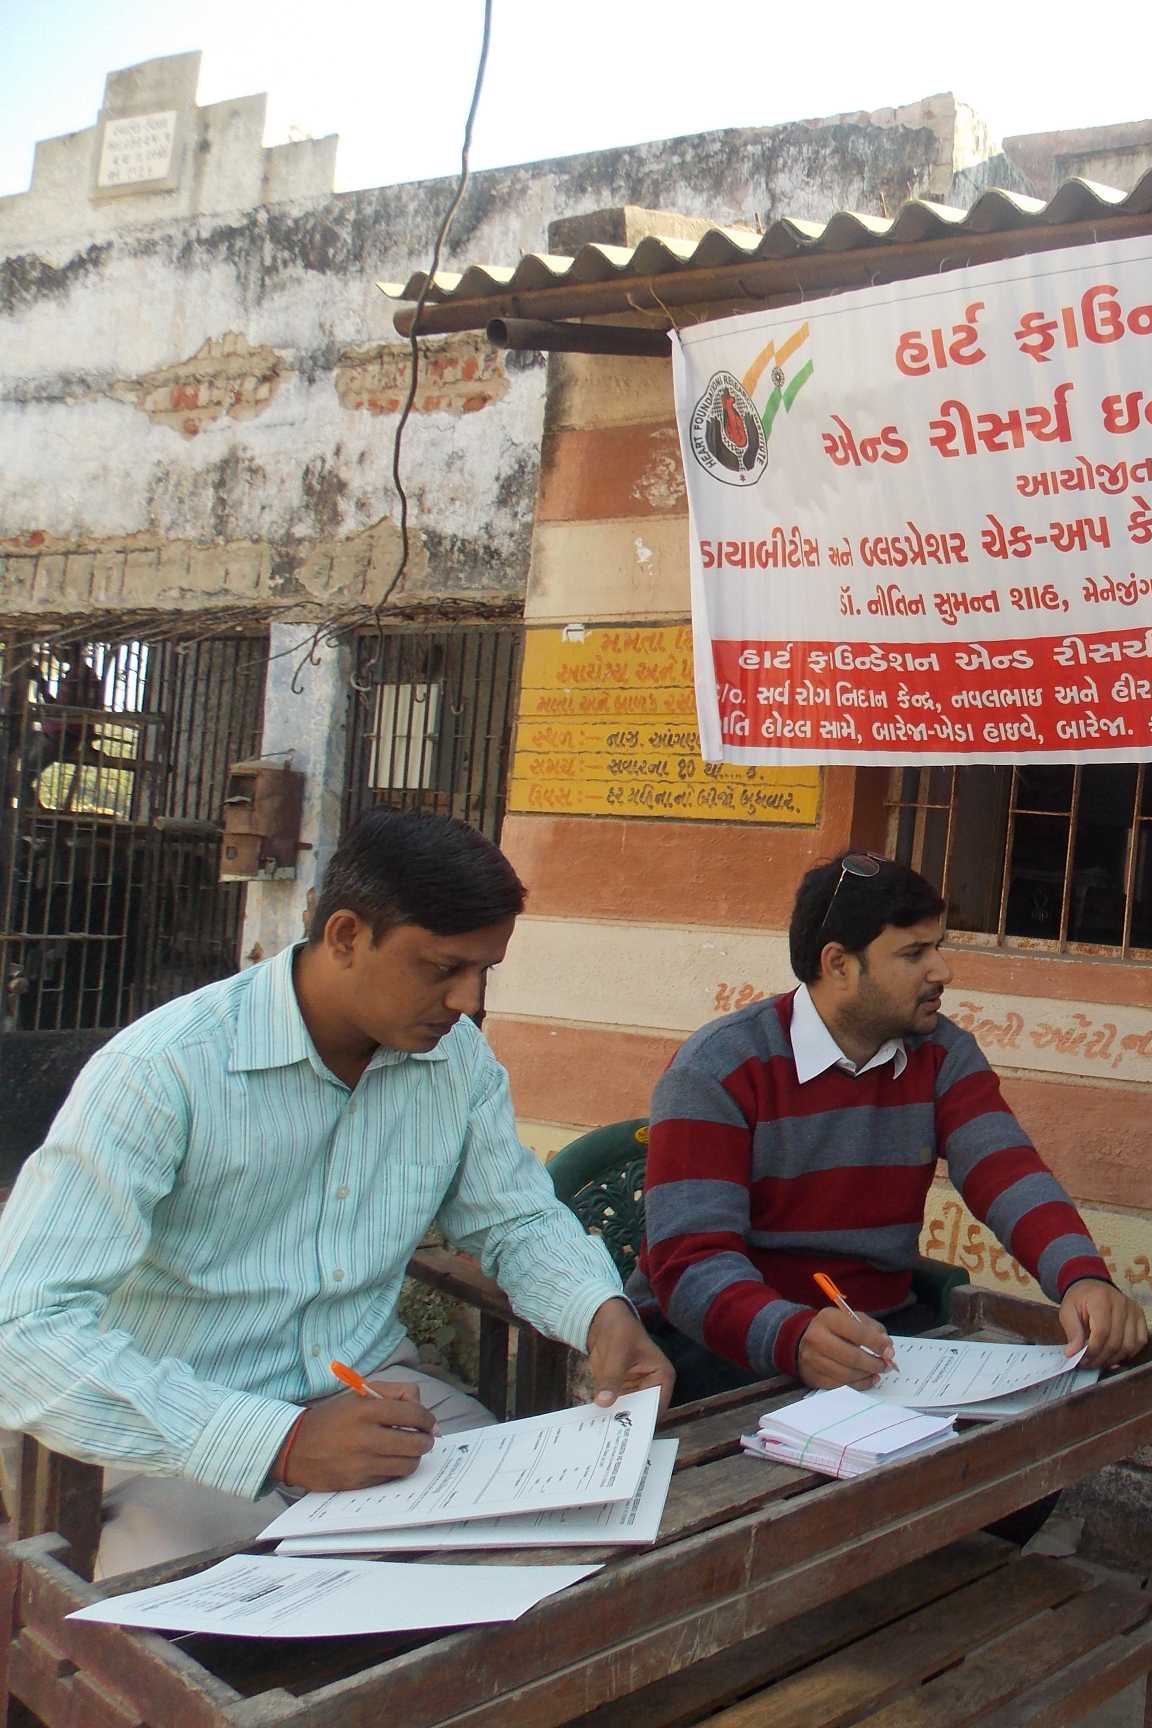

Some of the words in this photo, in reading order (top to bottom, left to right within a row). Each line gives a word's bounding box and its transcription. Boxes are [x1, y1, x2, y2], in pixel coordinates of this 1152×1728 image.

[896, 302, 986, 376] હાર્ટ
[822, 414, 910, 467] એન્ડ
[929, 383, 1074, 460] રીસર્ચ
[694, 437, 717, 468] HEART
[700, 526, 820, 568] ડાયાબીટીસ
[828, 537, 852, 567] અને
[860, 521, 969, 569] બ્લડપ્રેશર
[981, 514, 1110, 560] ચેક-અપ
[867, 583, 926, 616] નીતિન
[934, 588, 1000, 626] સુમન્ત
[1010, 582, 1070, 613] શાહ,
[738, 642, 793, 671] હાર્ટ
[807, 643, 941, 674] ફાઉન્ડેશન
[954, 642, 1035, 672] એન્ડ
[757, 680, 790, 706] સર્વ
[795, 679, 831, 706] રોગ
[835, 681, 888, 709] નિદાન
[1054, 676, 1100, 705] અને
[761, 711, 812, 739] હોટલ
[819, 713, 863, 744] સામે,
[872, 713, 974, 743] બારેજા-ખેડા
[1056, 710, 1134, 741] બારેજા.
